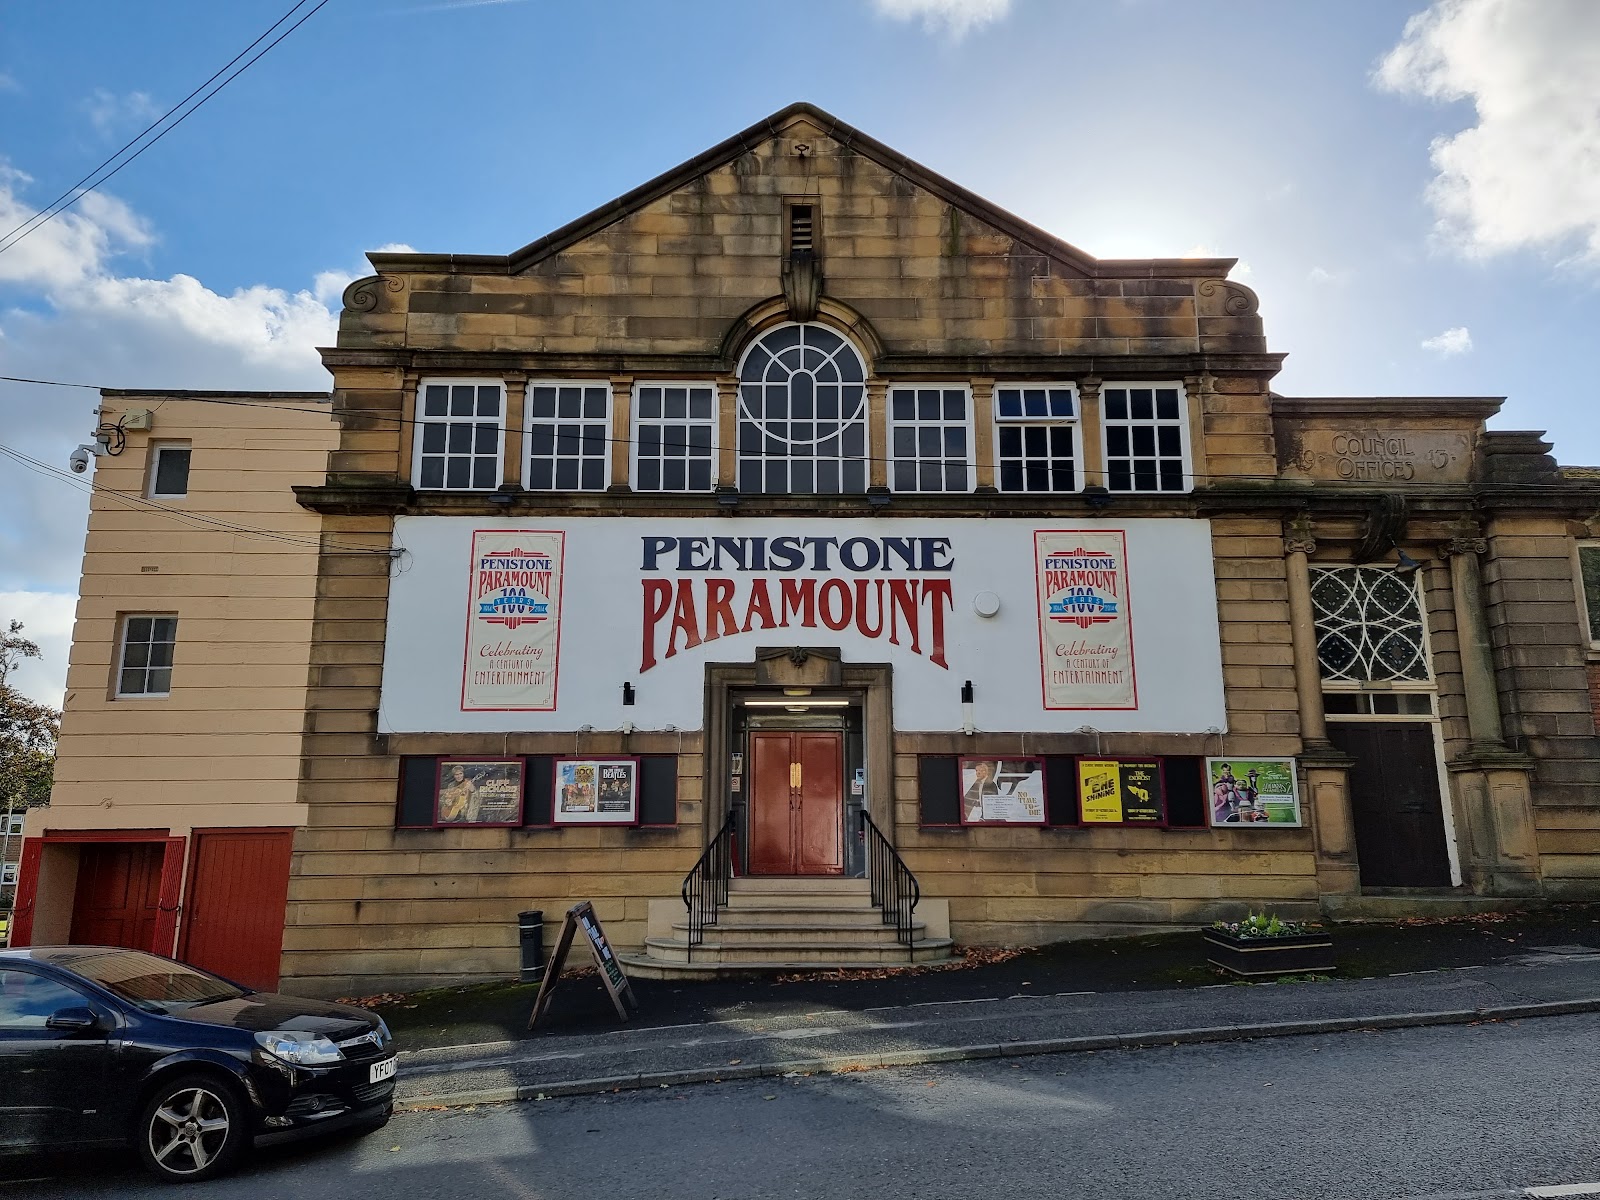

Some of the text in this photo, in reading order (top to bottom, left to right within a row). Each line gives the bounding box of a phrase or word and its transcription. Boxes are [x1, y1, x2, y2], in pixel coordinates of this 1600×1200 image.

[1332, 434, 1416, 458] COUNCIL
[1335, 457, 1415, 480] OFFICES
[639, 536, 955, 571] PENISTONE
[480, 558, 552, 570] PENISTONE
[1045, 558, 1117, 570] PENISTONE
[477, 571, 552, 600] PARAMOUNT
[1045, 570, 1118, 600] PARAMOUNT
[496, 597, 531, 605] YEARS
[1065, 596, 1101, 604] YEARS
[639, 578, 954, 674] PARAMOUNT
[479, 640, 544, 660] Celebrating
[1055, 640, 1119, 659] Celebrating
[489, 659, 533, 669] A CENTURY OF
[1066, 659, 1110, 669] A CENTURY OF
[474, 671, 546, 685] ENTERTAINMENT
[1053, 670, 1124, 685] ENTERTAINMENT
[575, 768, 595, 776] ROCK
[603, 768, 627, 780] BEATLES
